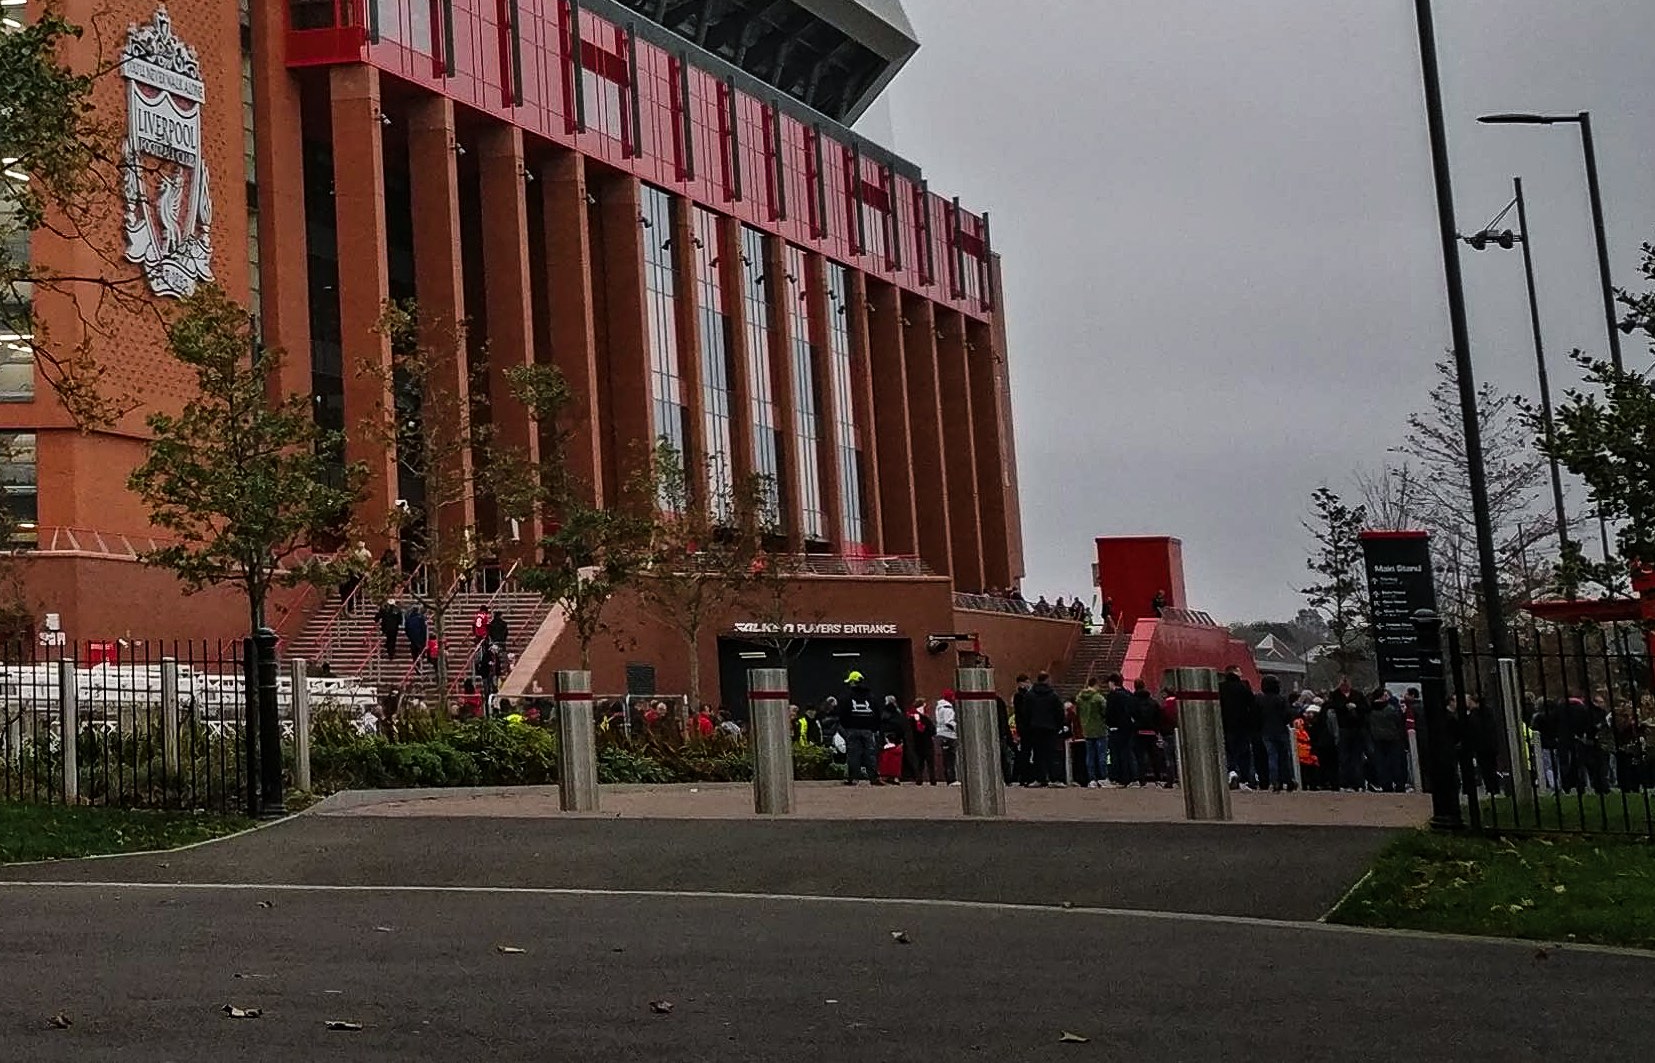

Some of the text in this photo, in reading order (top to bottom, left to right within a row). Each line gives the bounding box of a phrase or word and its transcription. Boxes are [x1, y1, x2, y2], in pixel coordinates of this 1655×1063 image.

[138, 108, 196, 149] LIVERPOOL
[1374, 564, 1422, 573] Main Stand
[797, 622, 842, 635] PLAYERS'
[843, 624, 897, 635] ENTRANCE
